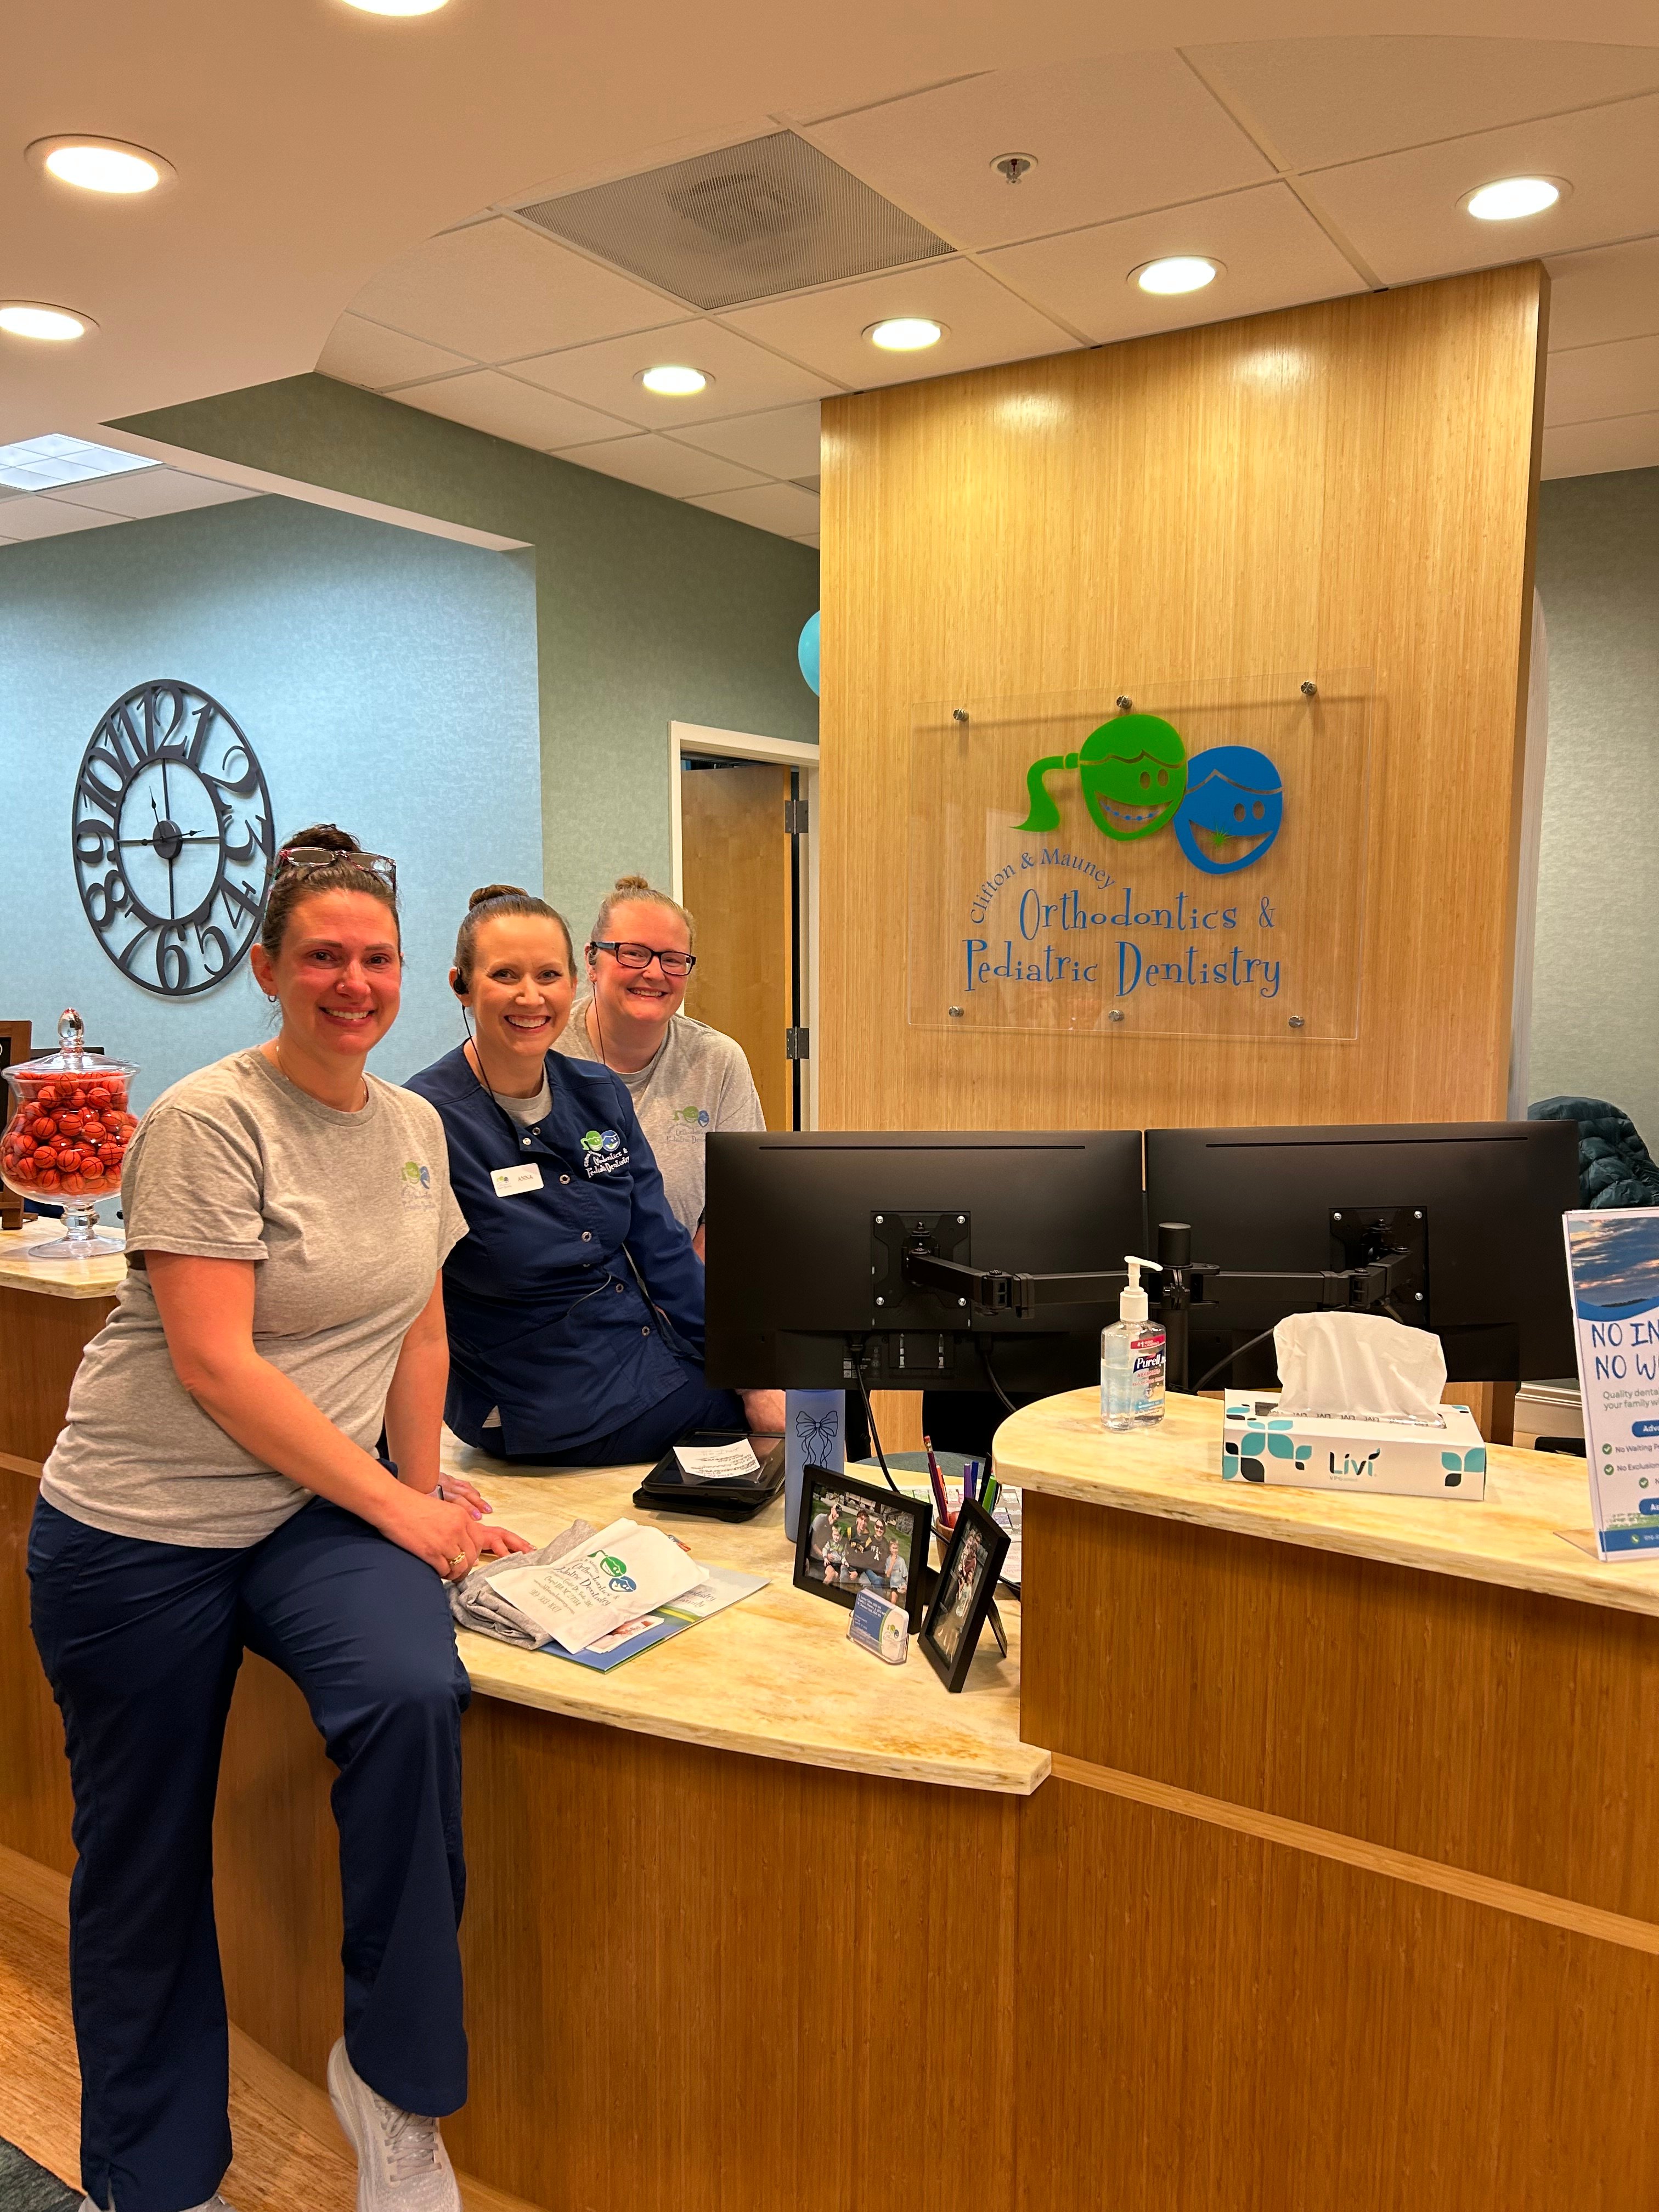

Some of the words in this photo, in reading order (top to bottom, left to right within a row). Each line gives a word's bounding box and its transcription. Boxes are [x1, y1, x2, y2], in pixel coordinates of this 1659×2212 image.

[104, 704, 147, 768] 11
[137, 685, 187, 757] 12
[192, 704, 214, 766] 1
[80, 747, 128, 814] 10
[201, 745, 257, 816] 2
[77, 819, 116, 864] 9
[223, 814, 273, 861] 3
[86, 870, 128, 928] 8
[221, 877, 261, 929] 4
[970, 865, 1016, 924] Clifton
[1021, 853, 1034, 869] &
[1041, 848, 1116, 889] Mauney
[1019, 888, 1237, 941] Orthodontics
[1259, 897, 1276, 929] &
[119, 902, 159, 968] 7
[156, 924, 189, 990] 6
[191, 901, 230, 976] 5
[962, 939, 1097, 992] Pediatric
[1115, 941, 1281, 998] Dentistry
[1137, 1354, 1161, 1369] Purell
[1592, 1323, 1623, 1348] NO
[1596, 1355, 1627, 1380] NO
[1637, 1354, 1659, 1380] W
[1603, 1390, 1633, 1400] Quality
[1635, 1388, 1659, 1396] denta
[1604, 1403, 1622, 1411] your
[1624, 1399, 1649, 1408] family
[1330, 1448, 1380, 1476] Livi
